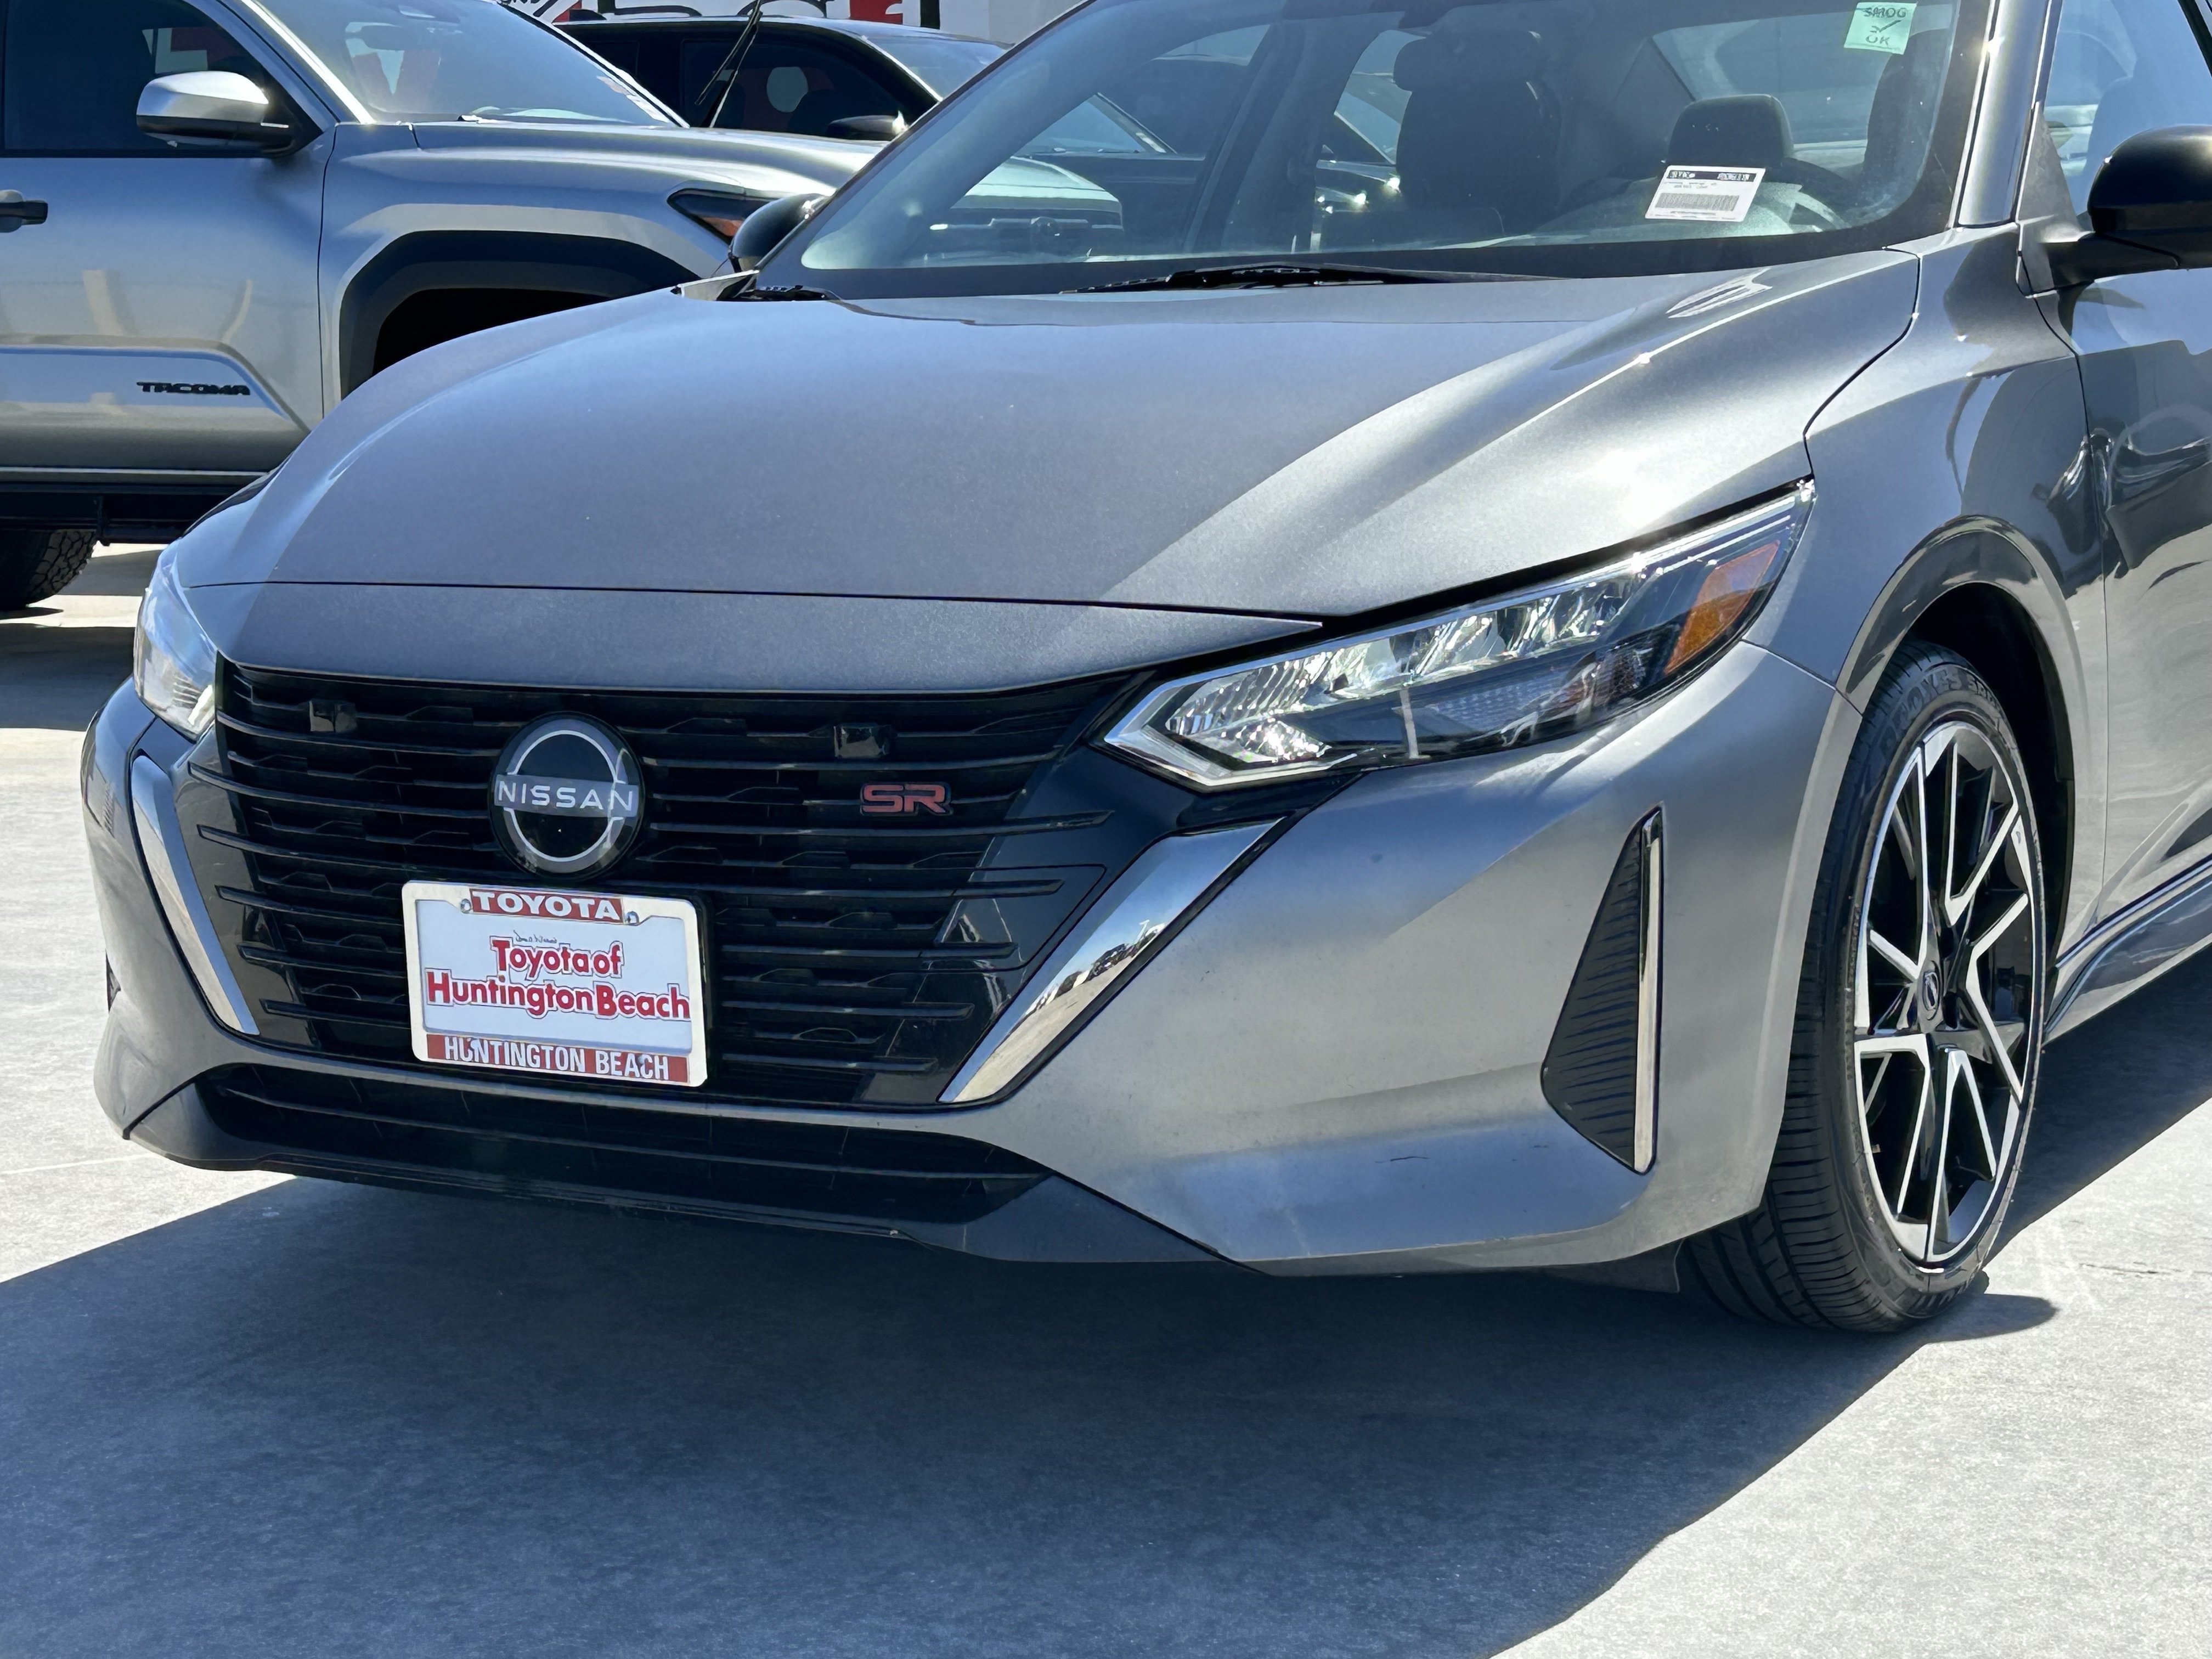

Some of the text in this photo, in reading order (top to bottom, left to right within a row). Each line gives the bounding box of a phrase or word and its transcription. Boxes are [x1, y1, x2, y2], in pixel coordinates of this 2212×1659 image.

[1865, 35, 1889, 45] OK
[136, 381, 251, 395] TACOMA
[498, 780, 633, 811] NISSAN
[862, 784, 946, 813] SR
[472, 892, 620, 921] TOYOTA
[444, 1036, 669, 1081] HUNTINGTON BEACH
